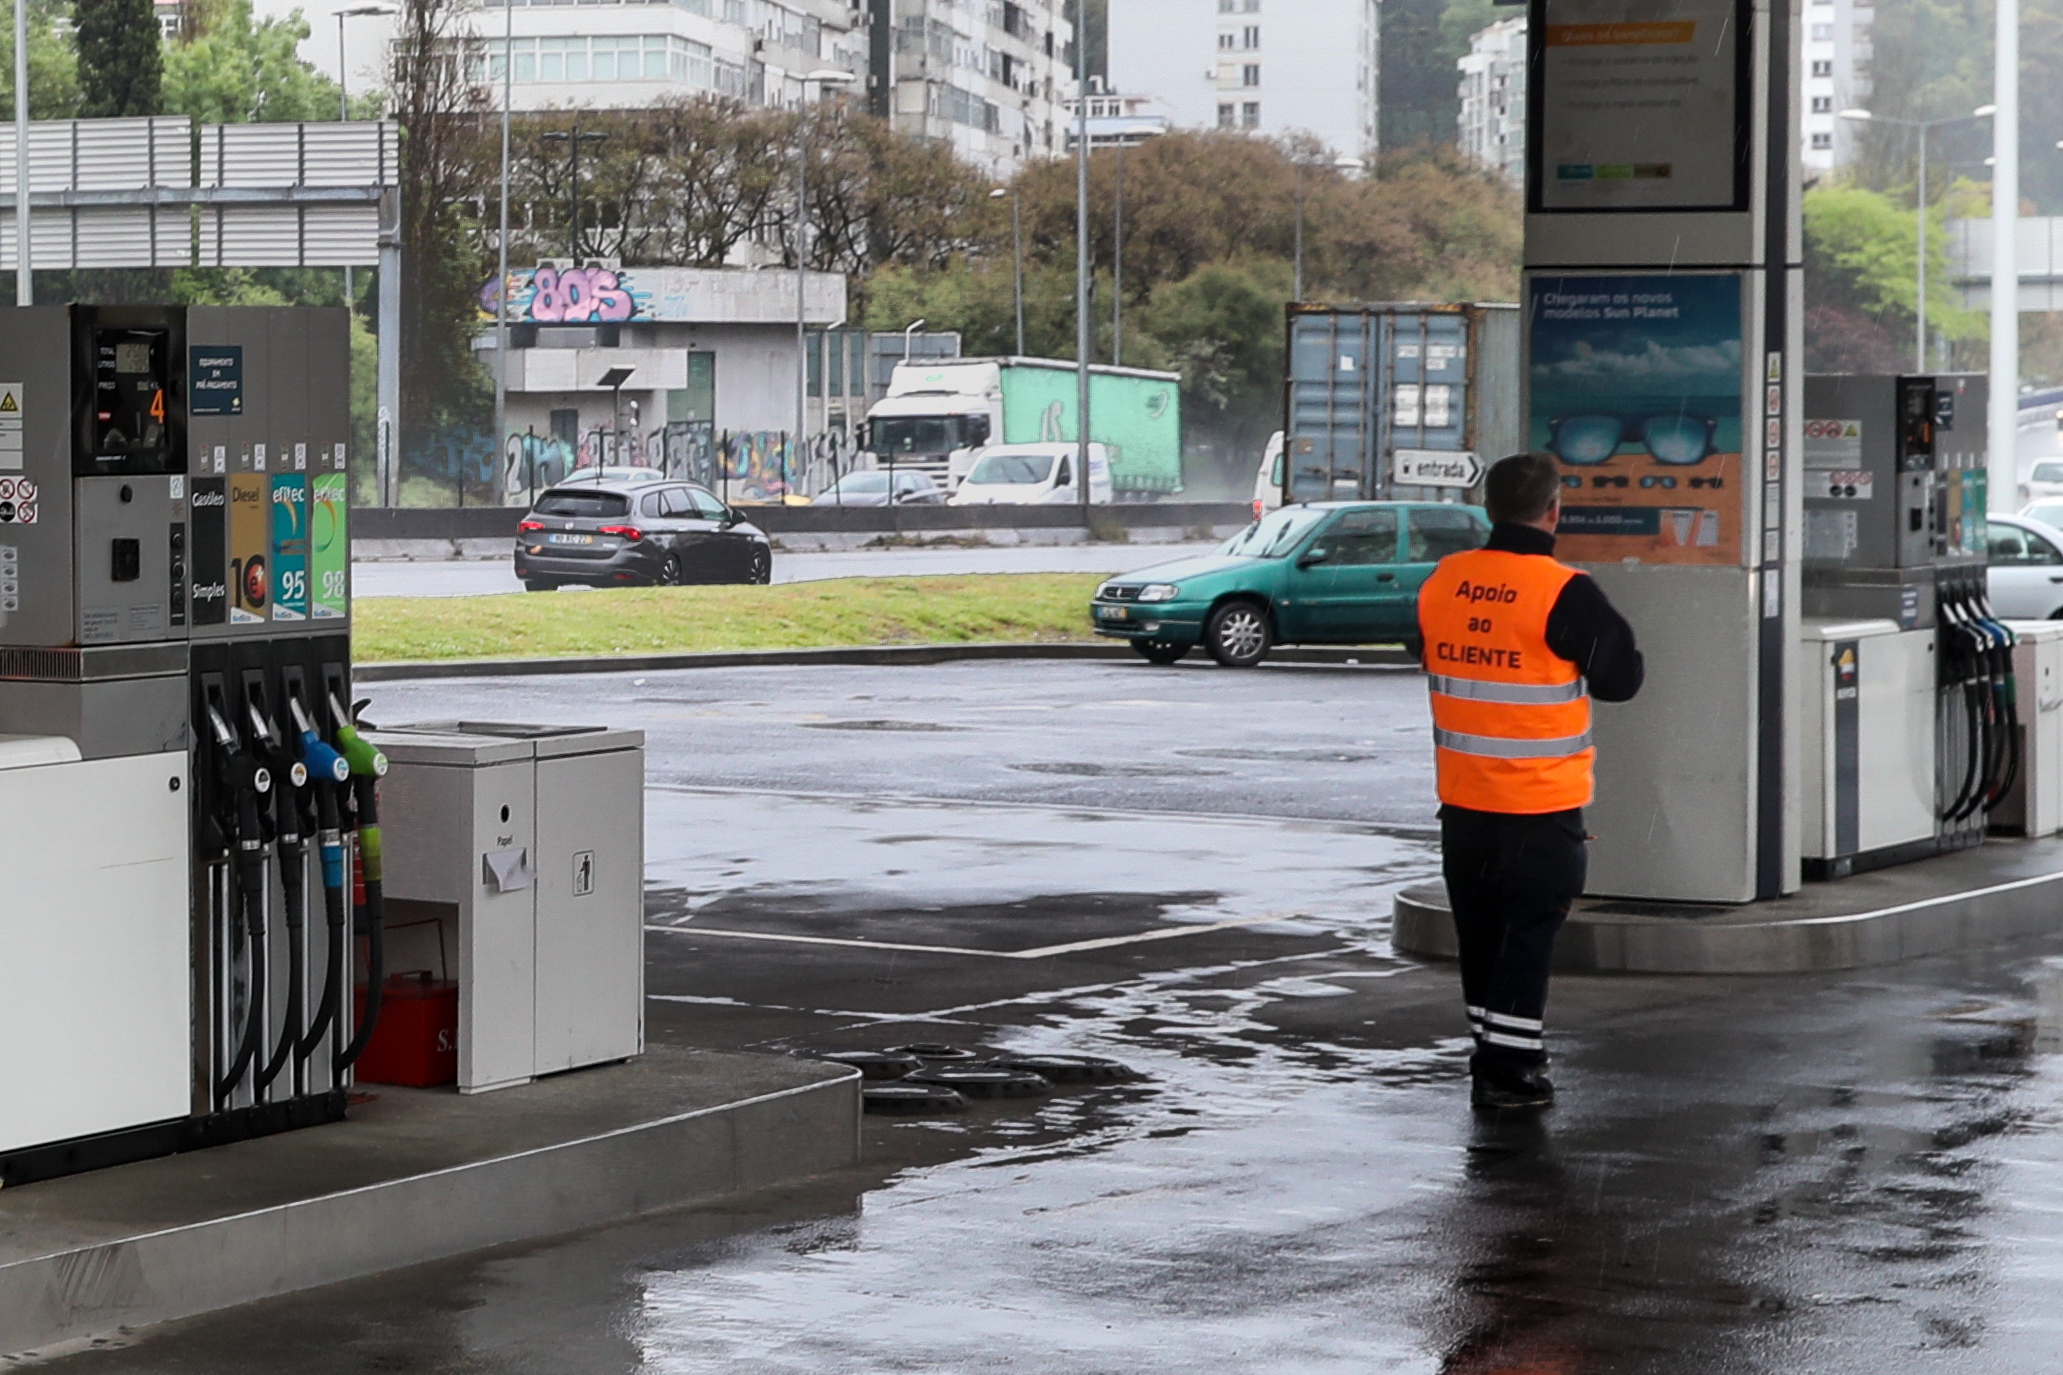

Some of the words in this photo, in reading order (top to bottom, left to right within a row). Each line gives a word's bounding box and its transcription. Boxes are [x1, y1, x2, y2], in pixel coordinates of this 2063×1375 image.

[1543, 292, 1610, 308] Chegaram
[1612, 294, 1629, 304] os
[1632, 293, 1673, 304] novos
[1543, 307, 1599, 319] modelos
[1603, 306, 1630, 319] Sun
[1633, 306, 1680, 319] Planet
[149, 389, 165, 425] 4
[1417, 461, 1465, 478] entrada
[232, 487, 260, 503] Diesel
[273, 485, 305, 503] efitec
[313, 486, 345, 504] efitec
[192, 581, 225, 602] Simples
[282, 570, 305, 600] 95
[322, 569, 345, 600] 98
[1455, 580, 1518, 604] Apoio
[1467, 617, 1492, 633] ao
[1437, 642, 1522, 669] CLIENTE
